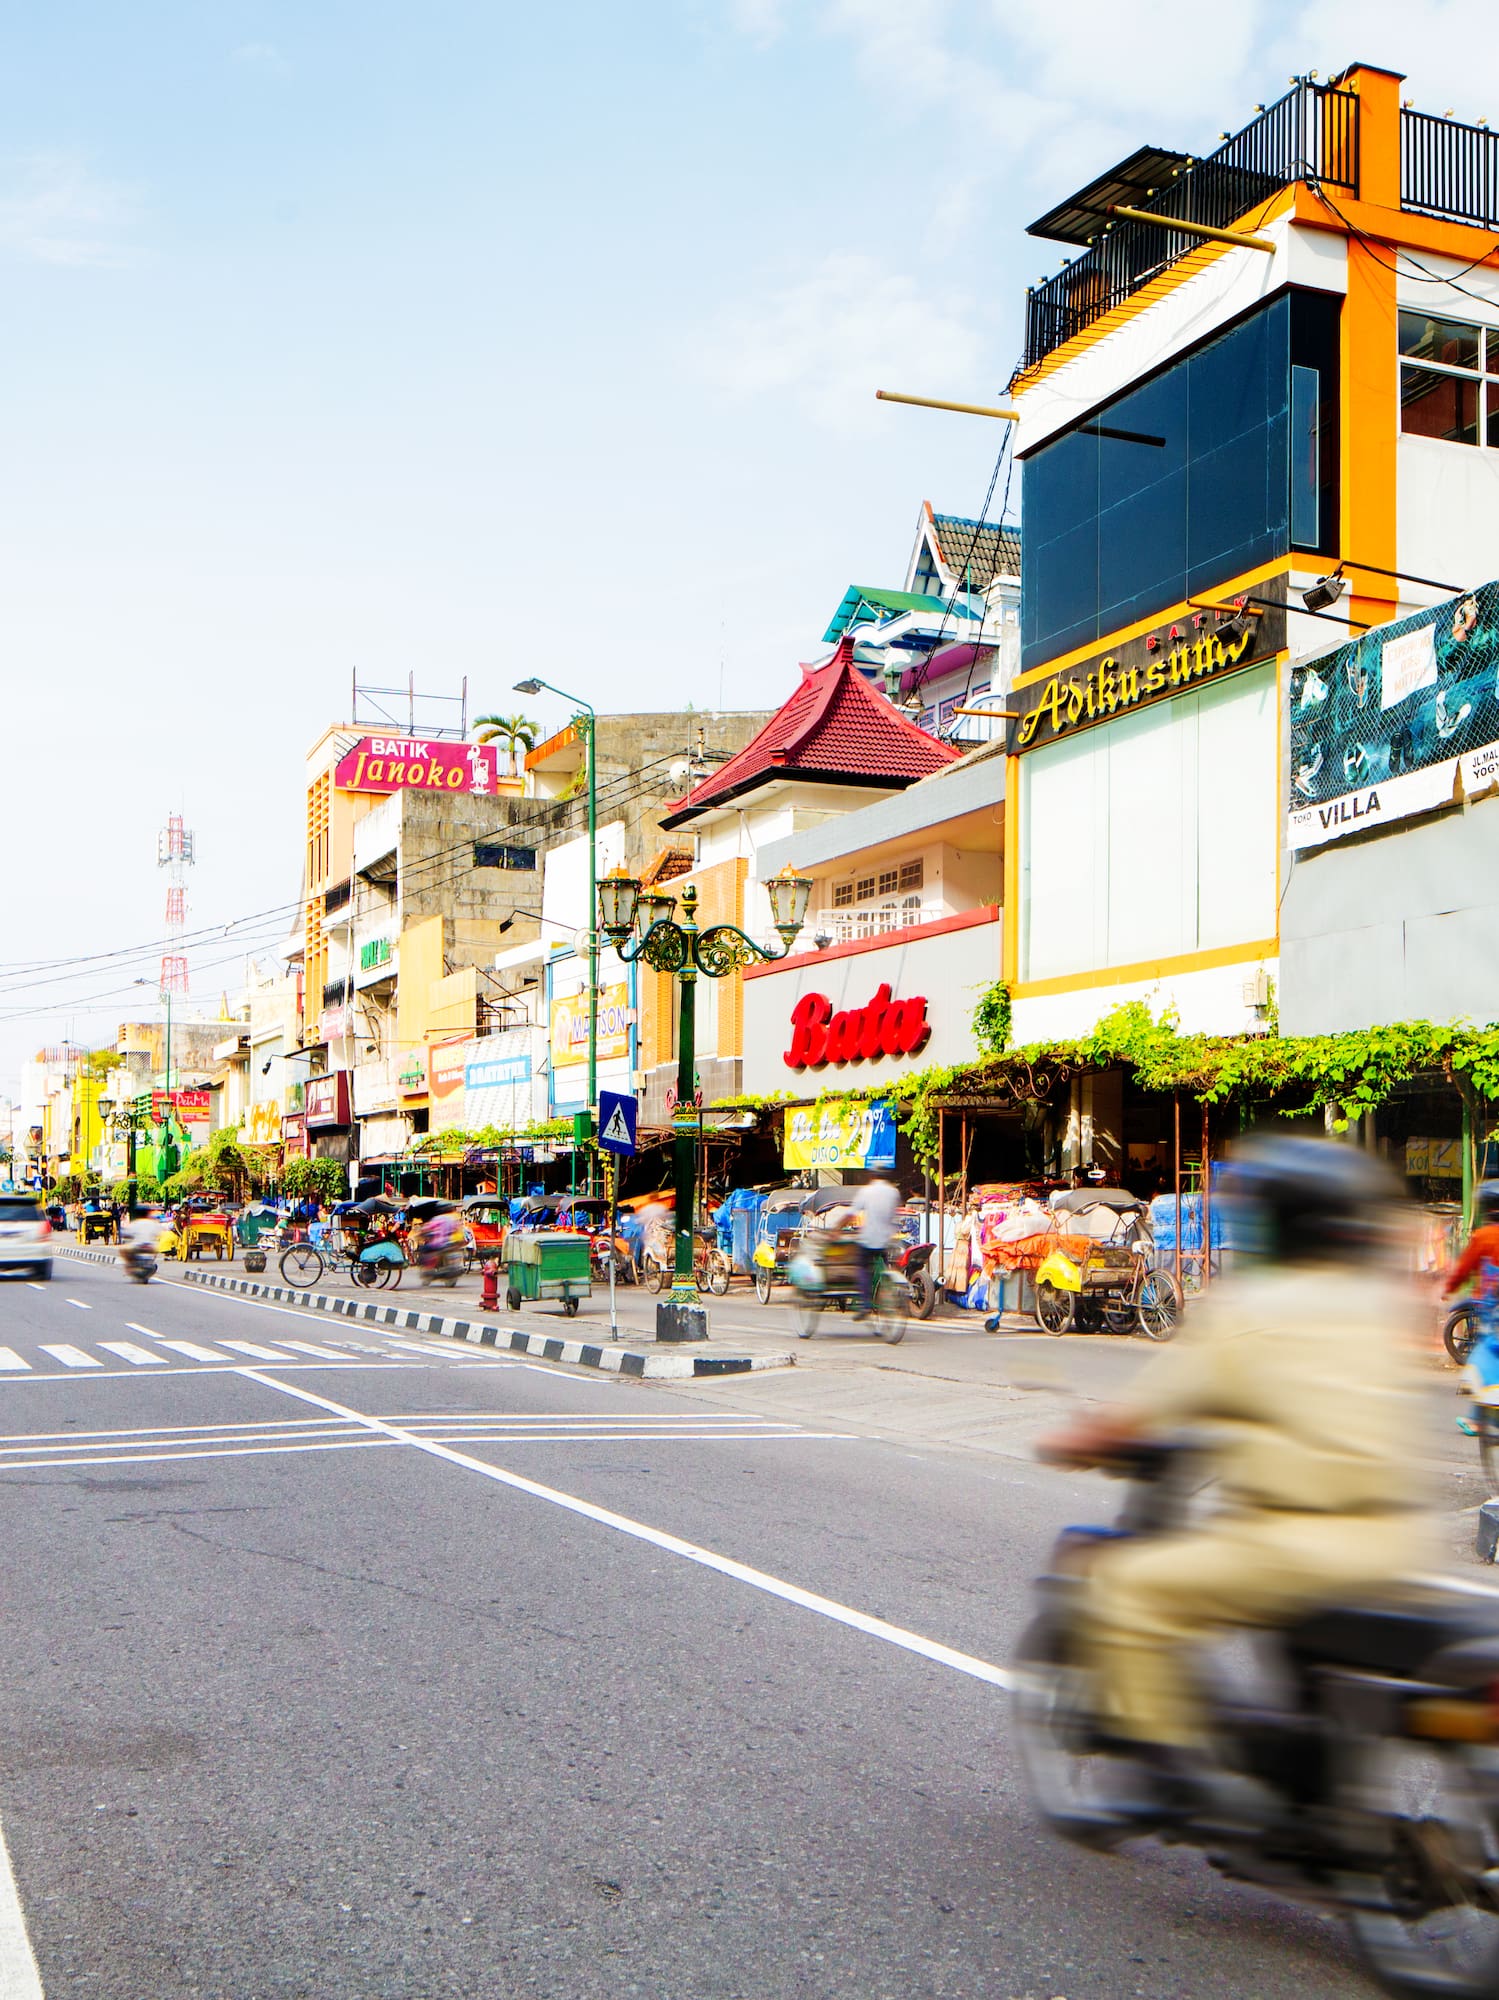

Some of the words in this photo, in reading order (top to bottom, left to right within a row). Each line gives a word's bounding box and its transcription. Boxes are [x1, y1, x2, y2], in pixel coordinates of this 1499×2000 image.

[1146, 595, 1247, 650] BATIK
[371, 739, 429, 759] BATIK
[346, 752, 464, 788] Janoko
[1293, 812, 1312, 825] TOKO
[1319, 791, 1381, 829] VILLA
[783, 983, 932, 1068] Bata
